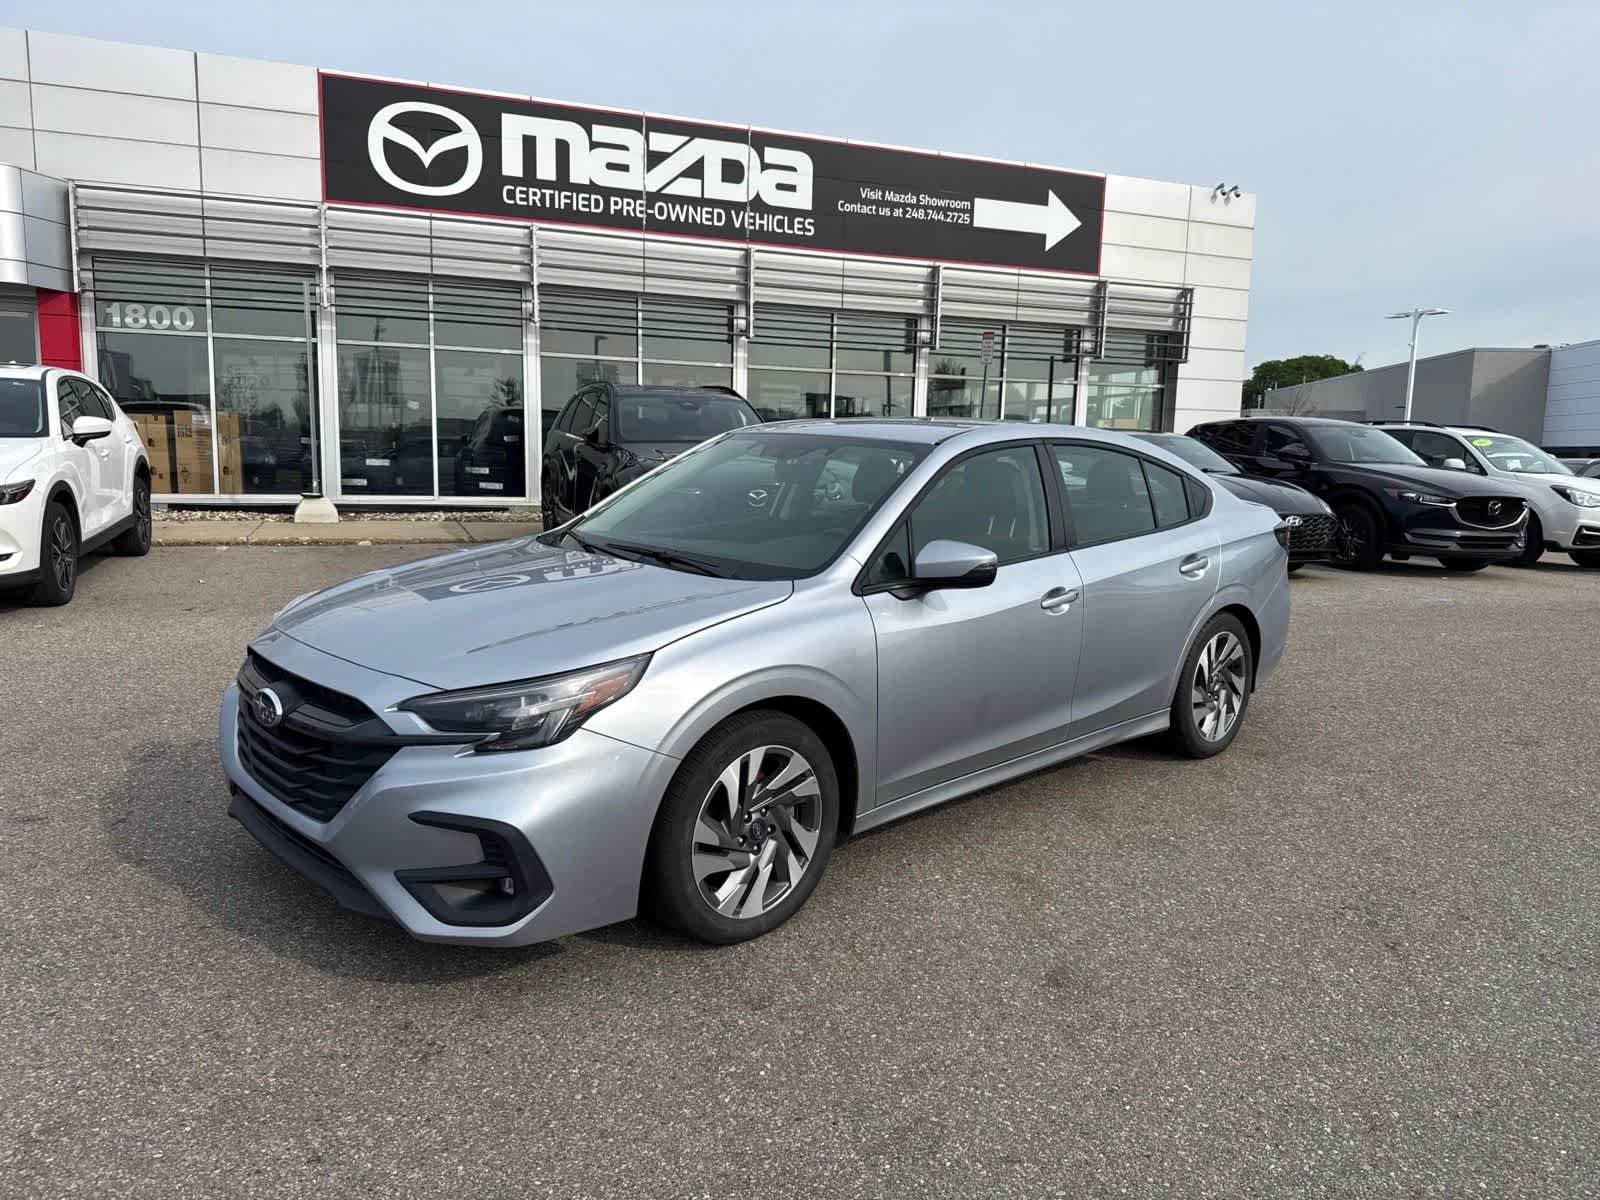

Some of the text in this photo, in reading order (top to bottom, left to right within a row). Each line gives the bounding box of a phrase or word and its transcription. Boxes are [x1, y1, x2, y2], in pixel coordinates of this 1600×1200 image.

[502, 185, 815, 236] CERTIFIED PRE-OWNED VEHICLES
[860, 187, 970, 209] Visit Mazda Showroom
[837, 200, 970, 224] Contact us at 248.744.2725
[106, 303, 195, 330] 1800
